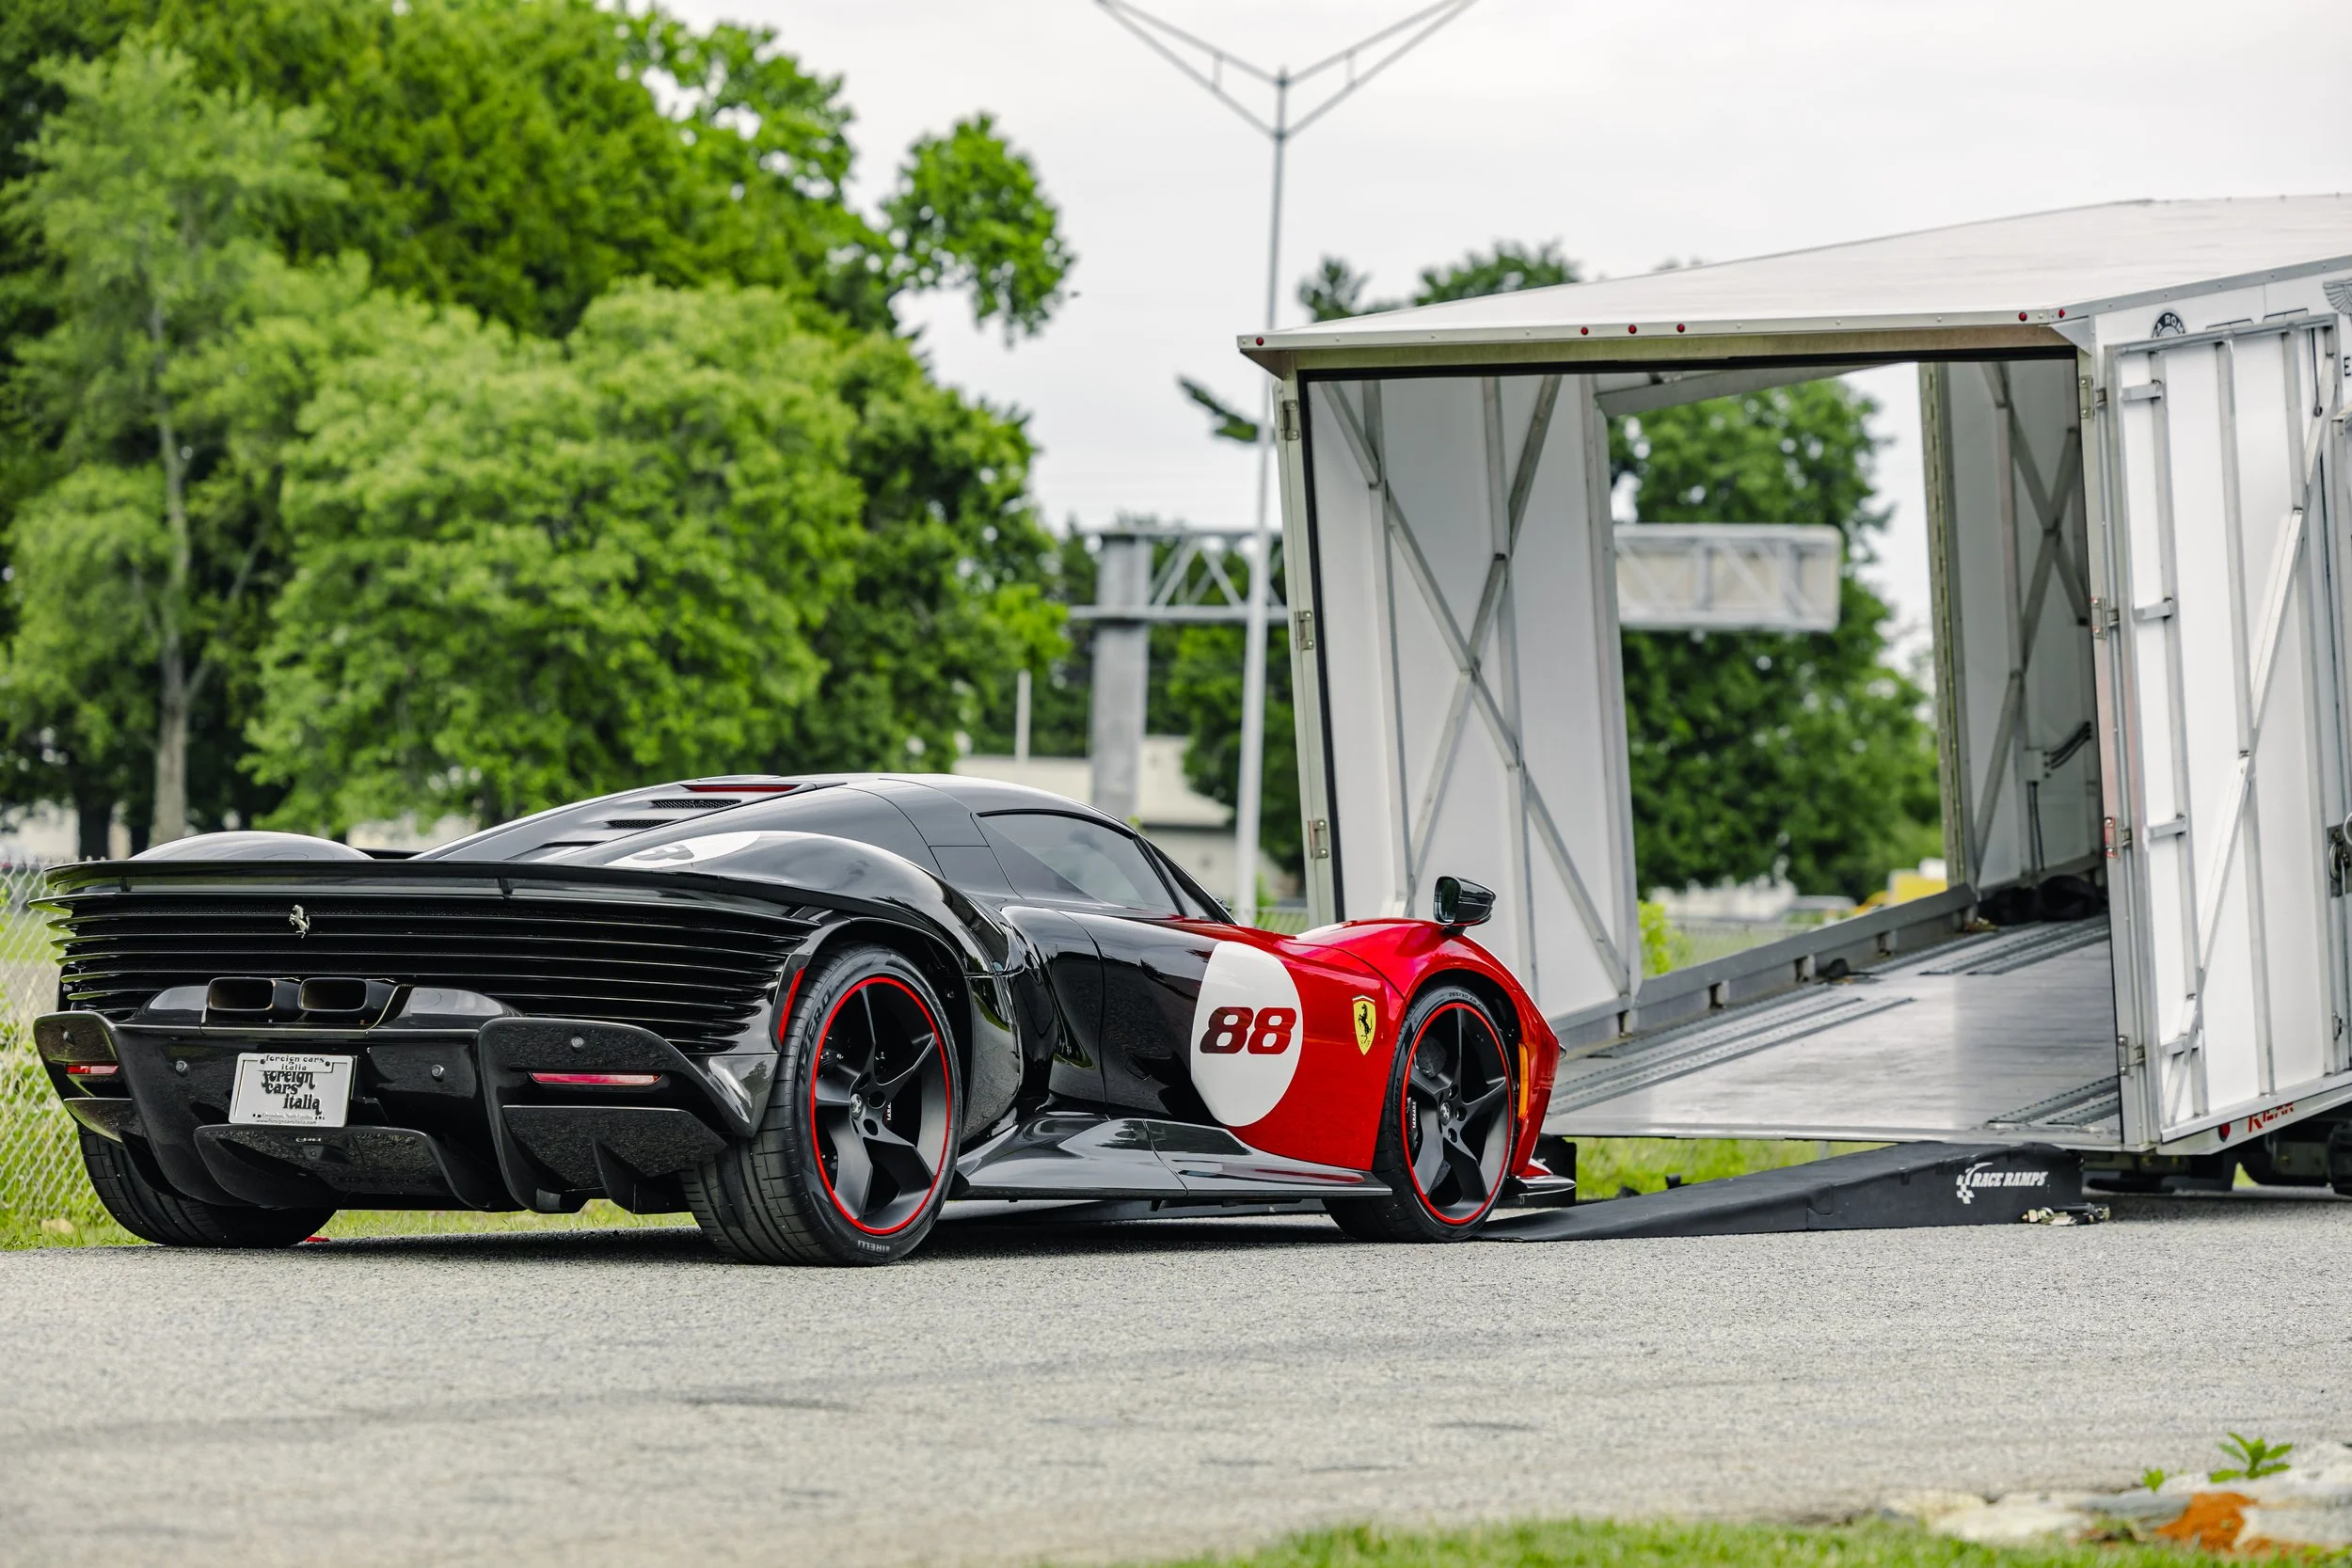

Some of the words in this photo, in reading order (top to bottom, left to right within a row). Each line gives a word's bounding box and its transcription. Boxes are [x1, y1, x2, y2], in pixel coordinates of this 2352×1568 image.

[1200, 1006, 1297, 1054] 88
[265, 1054, 300, 1065] foreign
[281, 1063, 307, 1071] italia
[262, 1070, 316, 1089] foreign
[264, 1083, 299, 1095] cars
[283, 1093, 322, 1116] italia
[1971, 1172, 2004, 1187] RACE
[2003, 1171, 2049, 1187] RAMPS
[857, 1239, 891, 1254] PIRELLI
